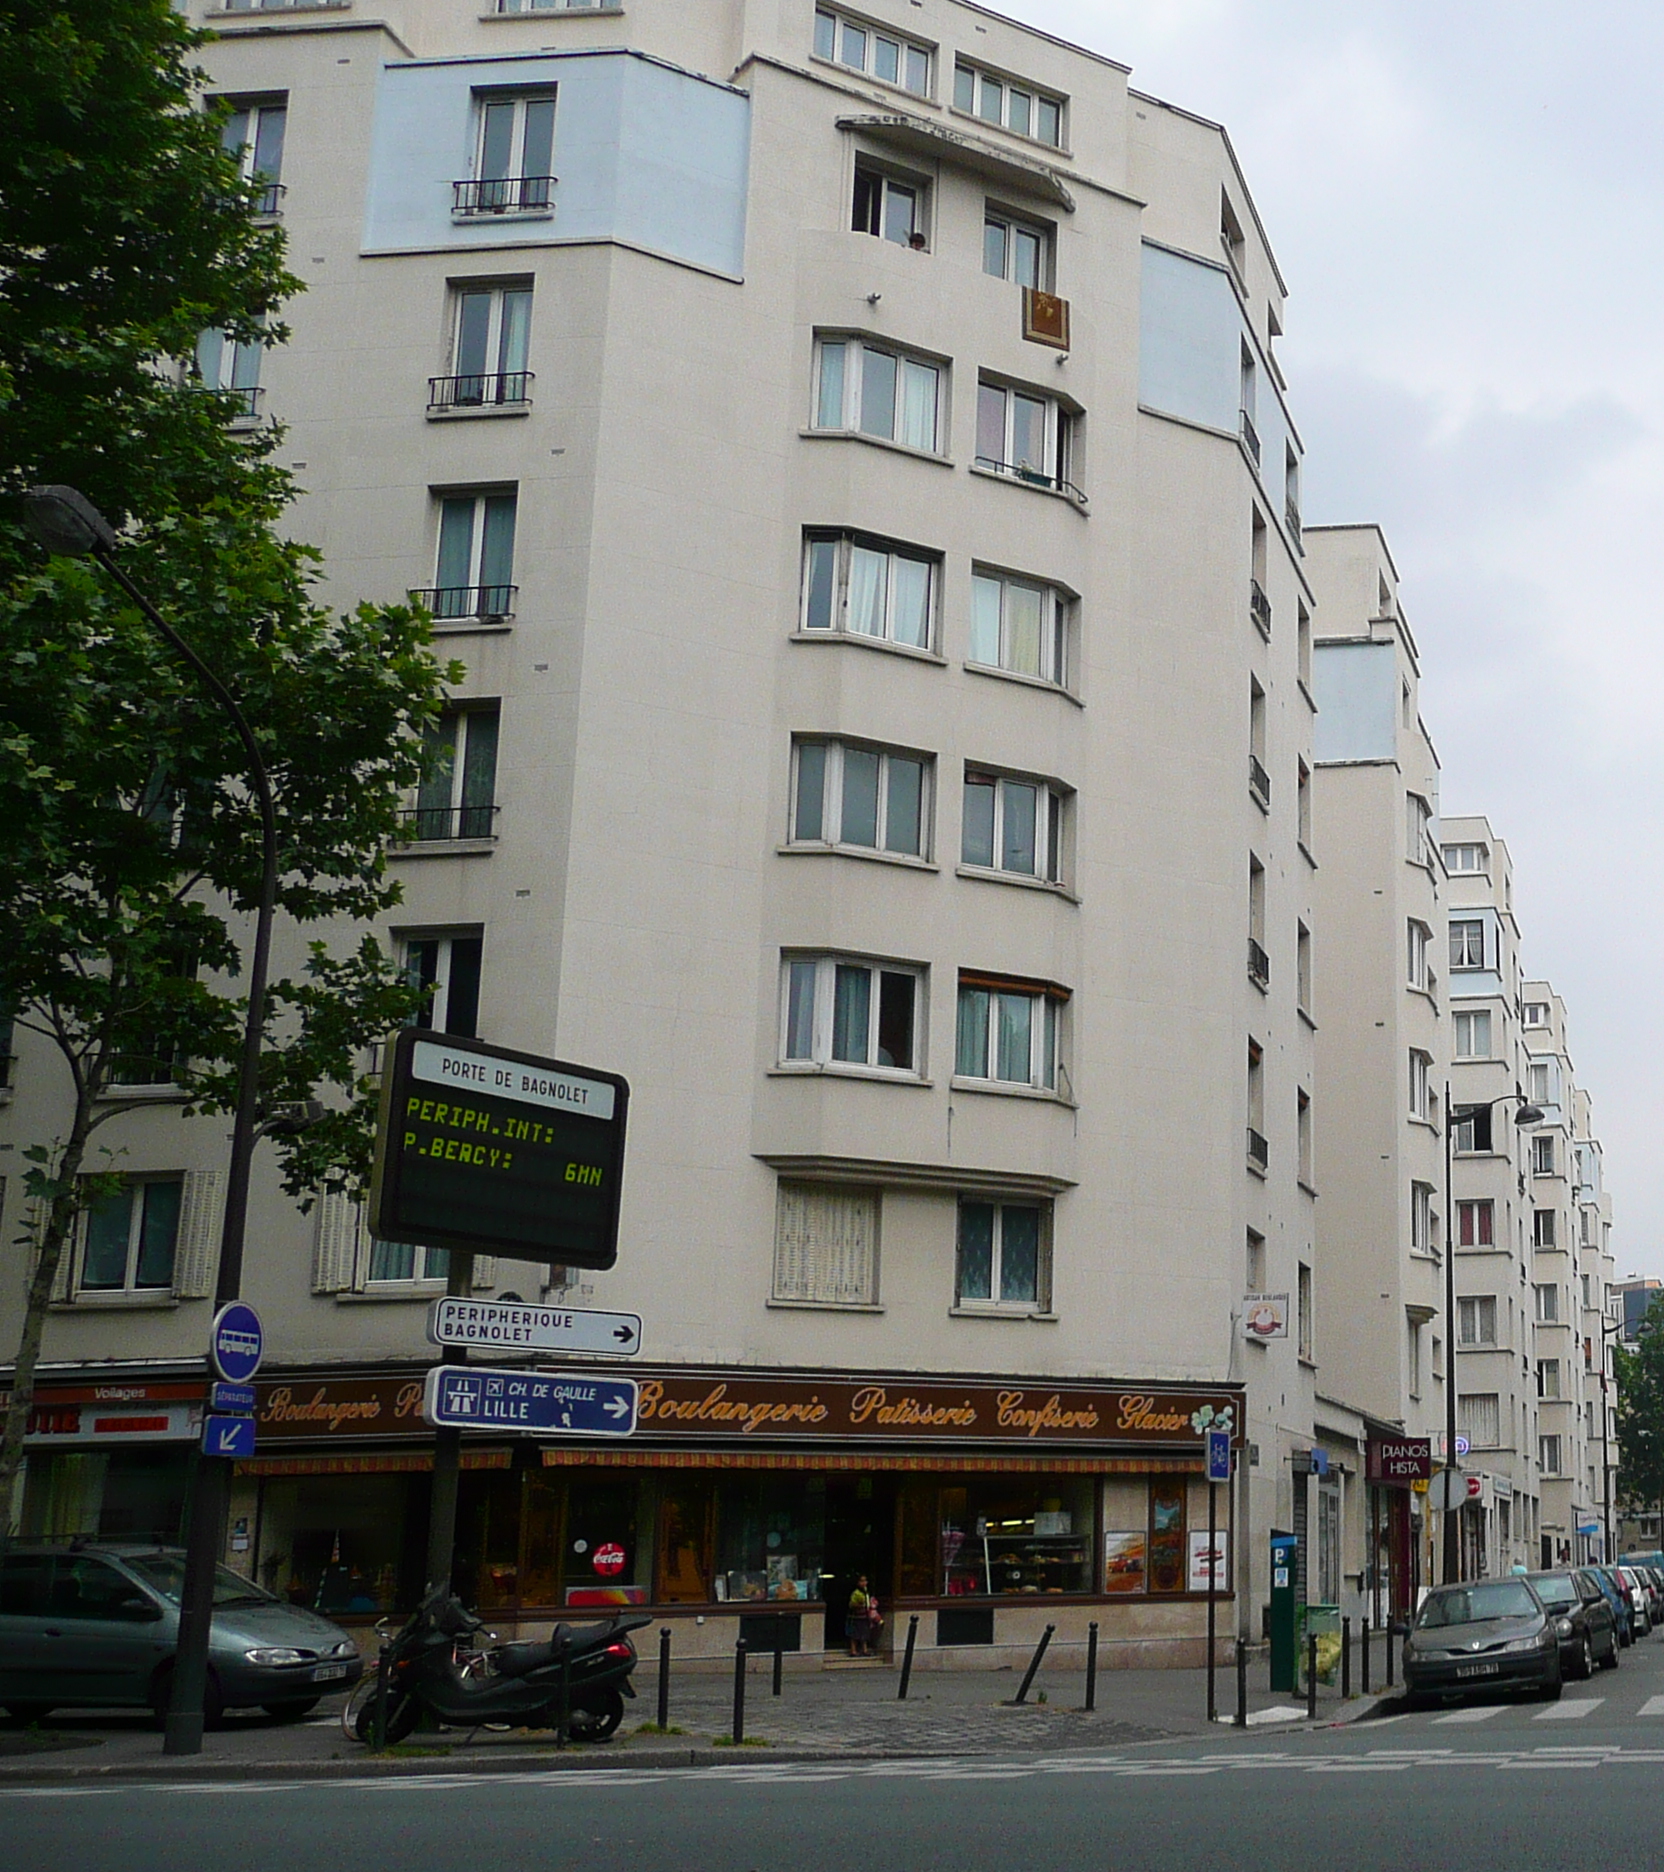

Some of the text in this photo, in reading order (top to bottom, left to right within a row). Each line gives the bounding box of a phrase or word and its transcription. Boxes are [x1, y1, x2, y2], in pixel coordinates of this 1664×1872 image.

[441, 1058, 589, 1105] PORTE DE BAGNOLET
[564, 1163, 603, 1187] 6MN
[446, 1306, 573, 1328] PERIPHERIQUE
[444, 1323, 532, 1341] BAGNOLET
[94, 1387, 146, 1401] Voilages
[532, 1384, 549, 1397] DE
[553, 1386, 597, 1401] GAULLE
[261, 1387, 381, 1431] Boulangerie
[484, 1400, 530, 1419] LILLE
[637, 1380, 829, 1433] Boulangerie
[996, 1391, 1100, 1437] Confiserie
[1117, 1395, 1188, 1431] Glacier
[1382, 1444, 1428, 1459] PIANOS
[1390, 1461, 1420, 1475] HISTA
[1275, 1548, 1285, 1563] P
